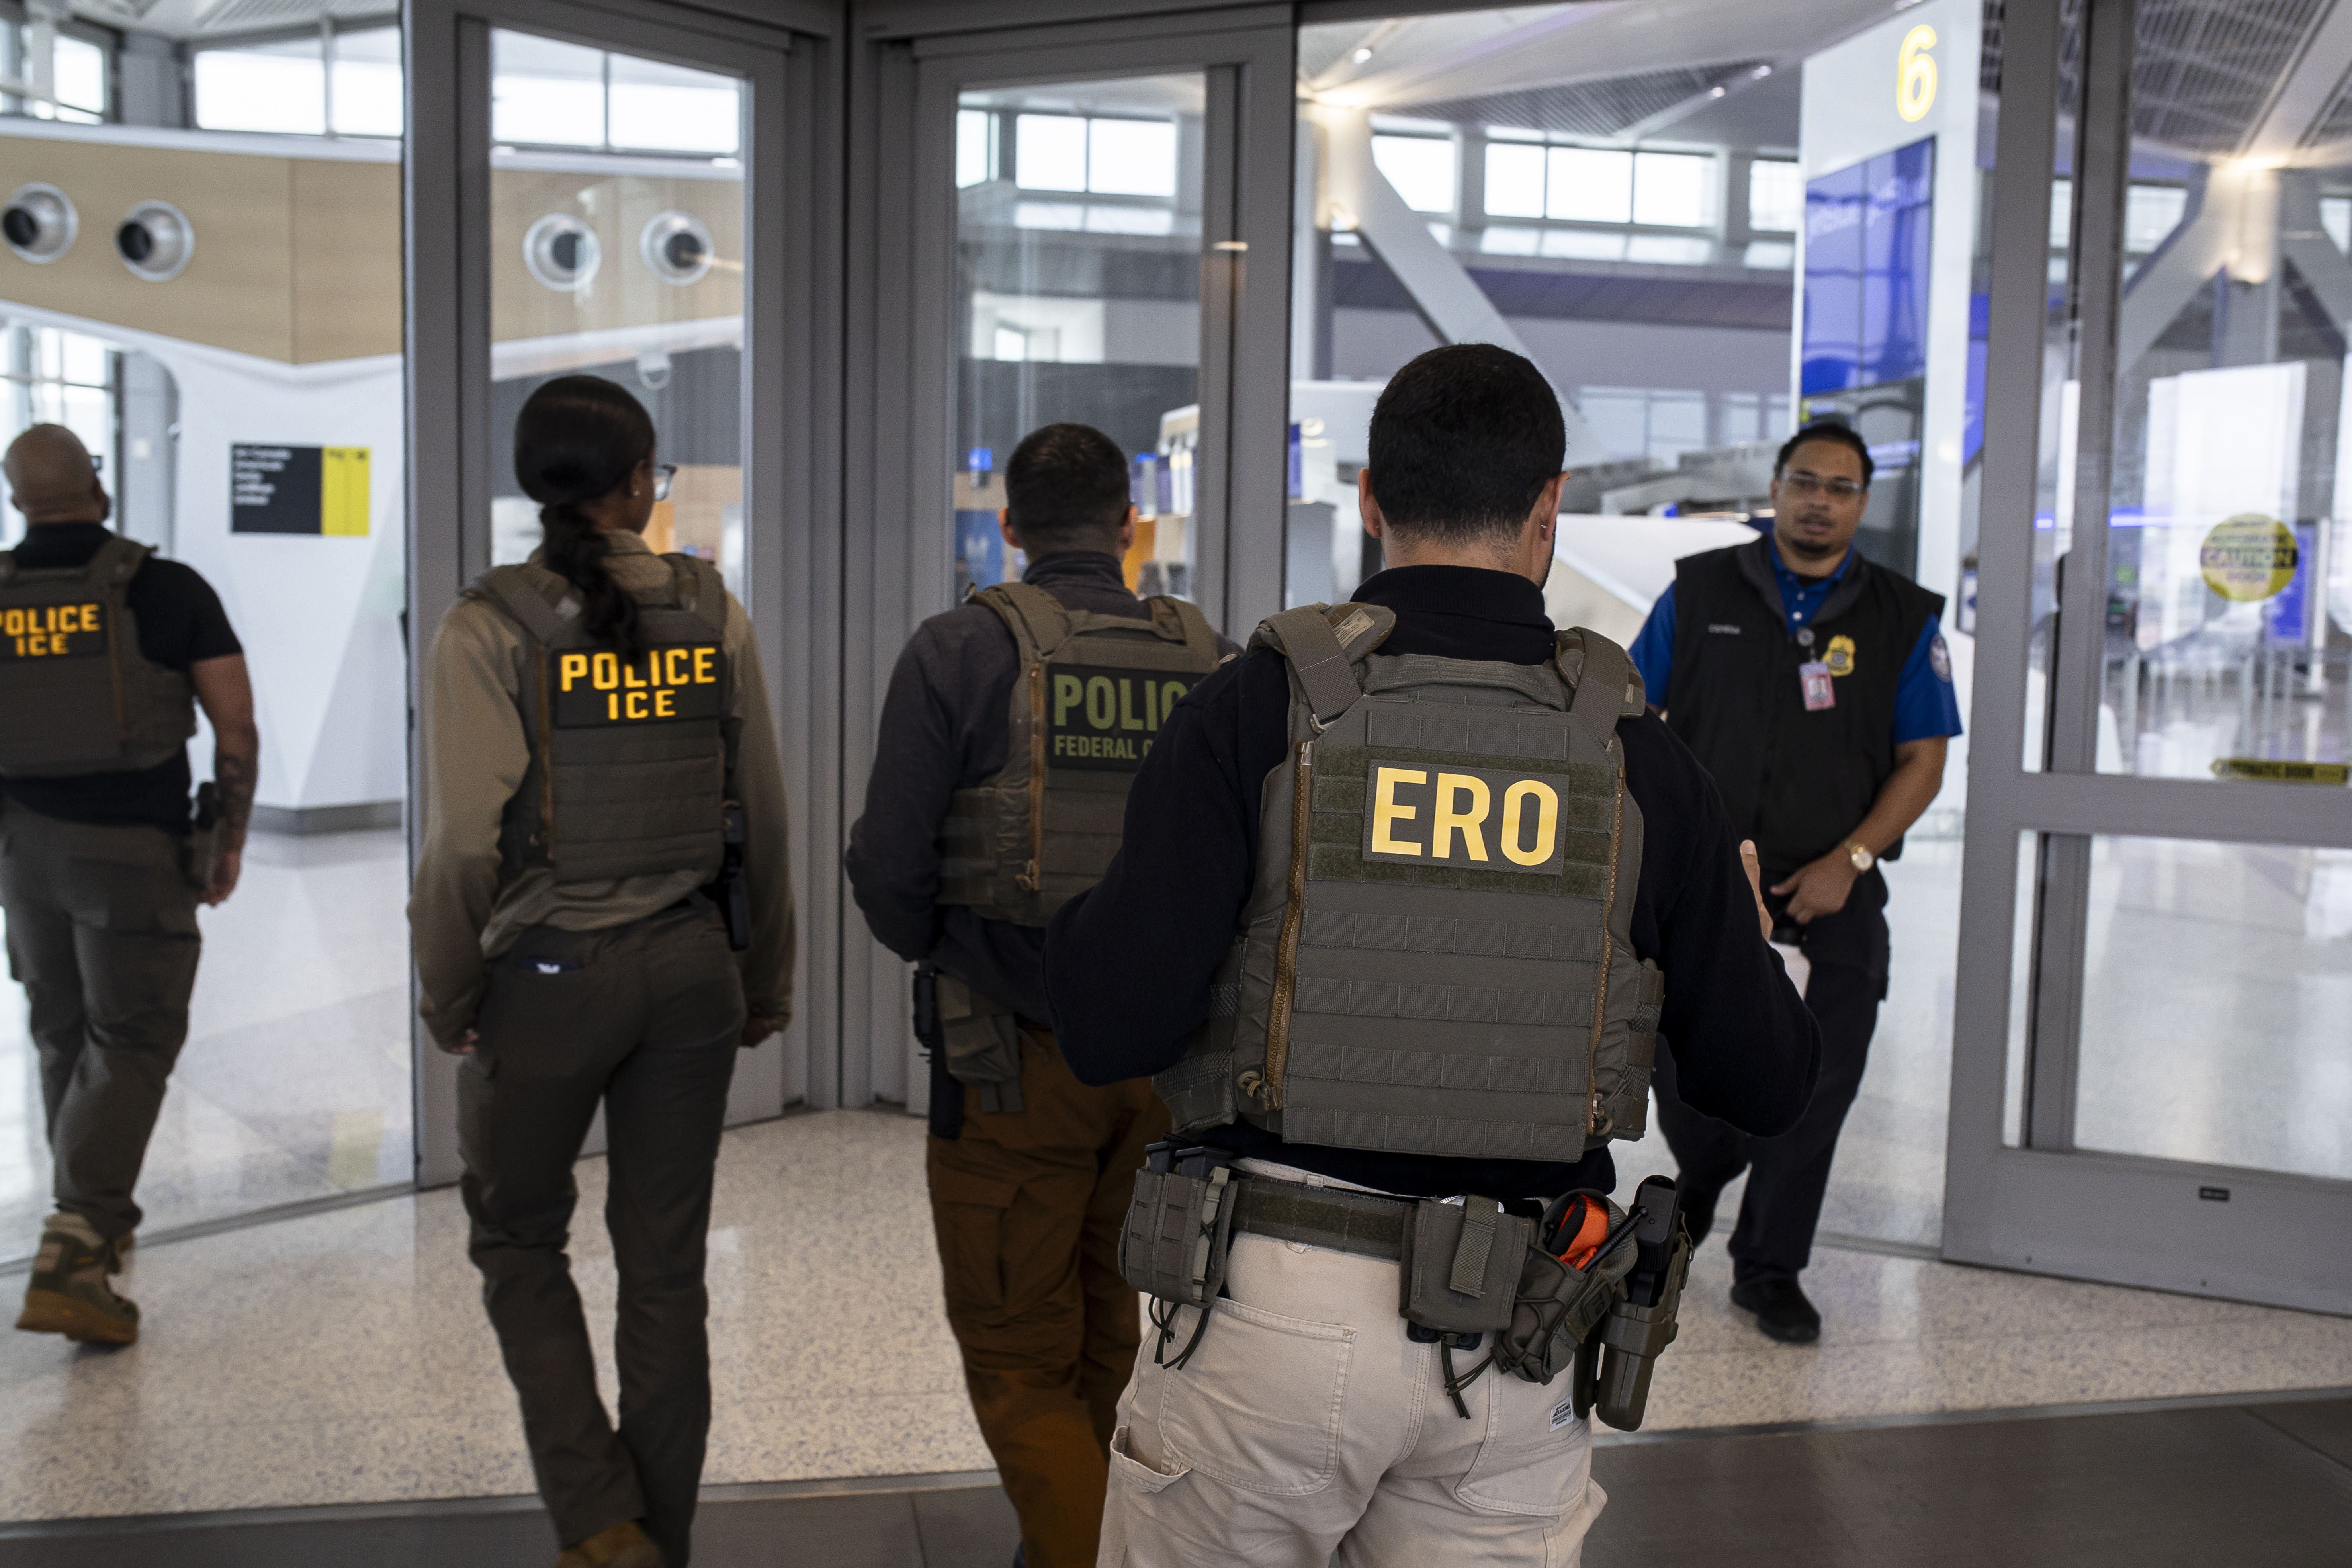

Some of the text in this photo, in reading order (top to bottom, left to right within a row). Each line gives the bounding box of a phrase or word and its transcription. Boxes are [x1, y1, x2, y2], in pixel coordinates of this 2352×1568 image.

[1897, 24, 1938, 123] 6
[0, 603, 100, 636] OLICE
[16, 633, 69, 656] ICE
[561, 647, 716, 692] POLICE
[608, 689, 676, 720] ICE
[1054, 674, 1197, 731] POLIC
[1054, 735, 1137, 760] FEDERAL
[1372, 767, 1558, 866] ERO
